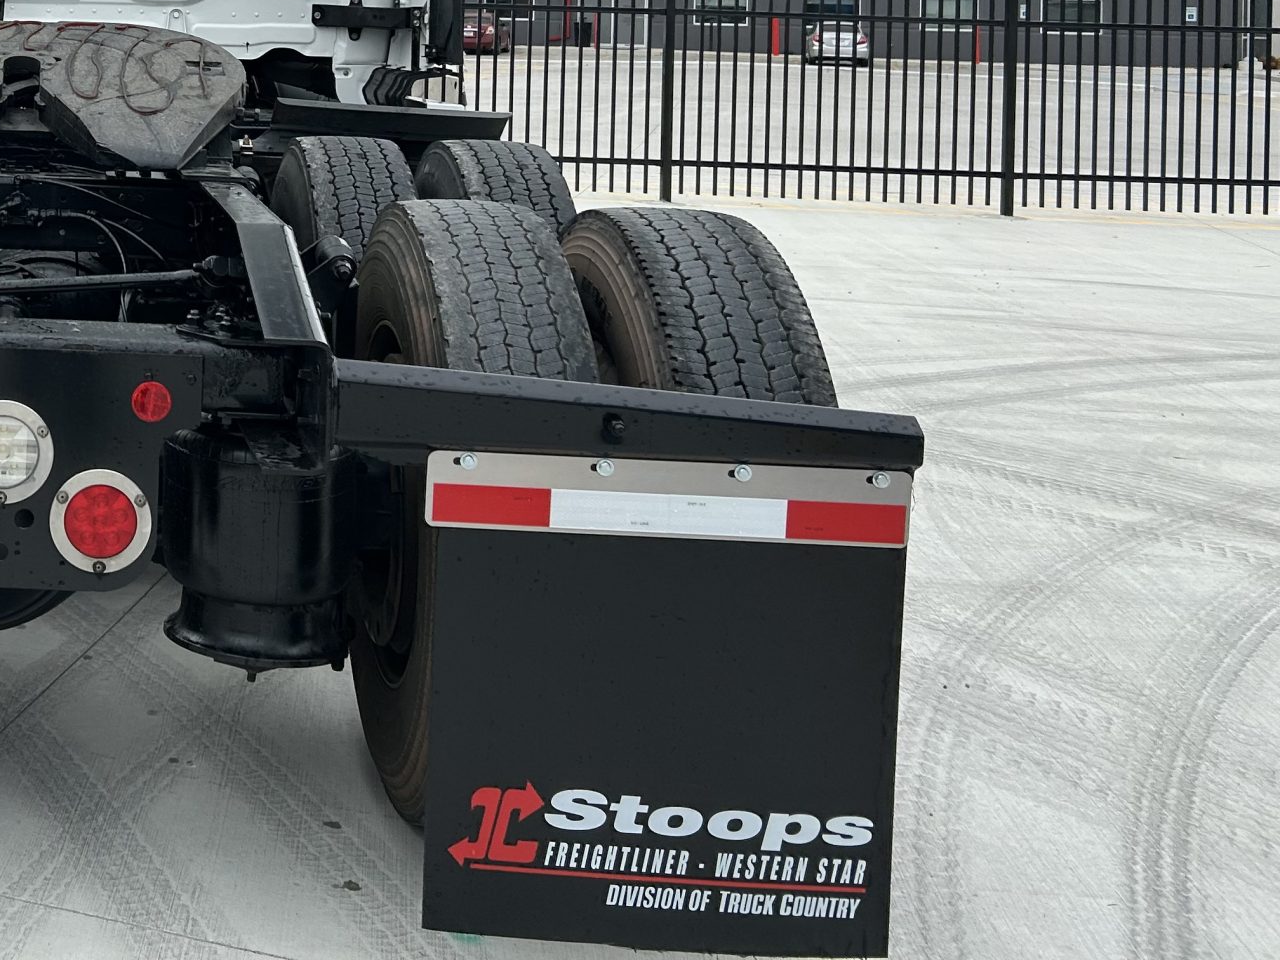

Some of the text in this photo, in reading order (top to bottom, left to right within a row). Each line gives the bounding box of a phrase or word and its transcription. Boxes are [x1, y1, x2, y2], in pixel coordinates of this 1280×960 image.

[543, 788, 874, 852] Stoops
[543, 841, 690, 876] FREIGHTLINER
[714, 852, 809, 882] WESTERN
[815, 857, 867, 885] STAR
[605, 884, 861, 919] DIVISION OF TRUCK COUNTRY
